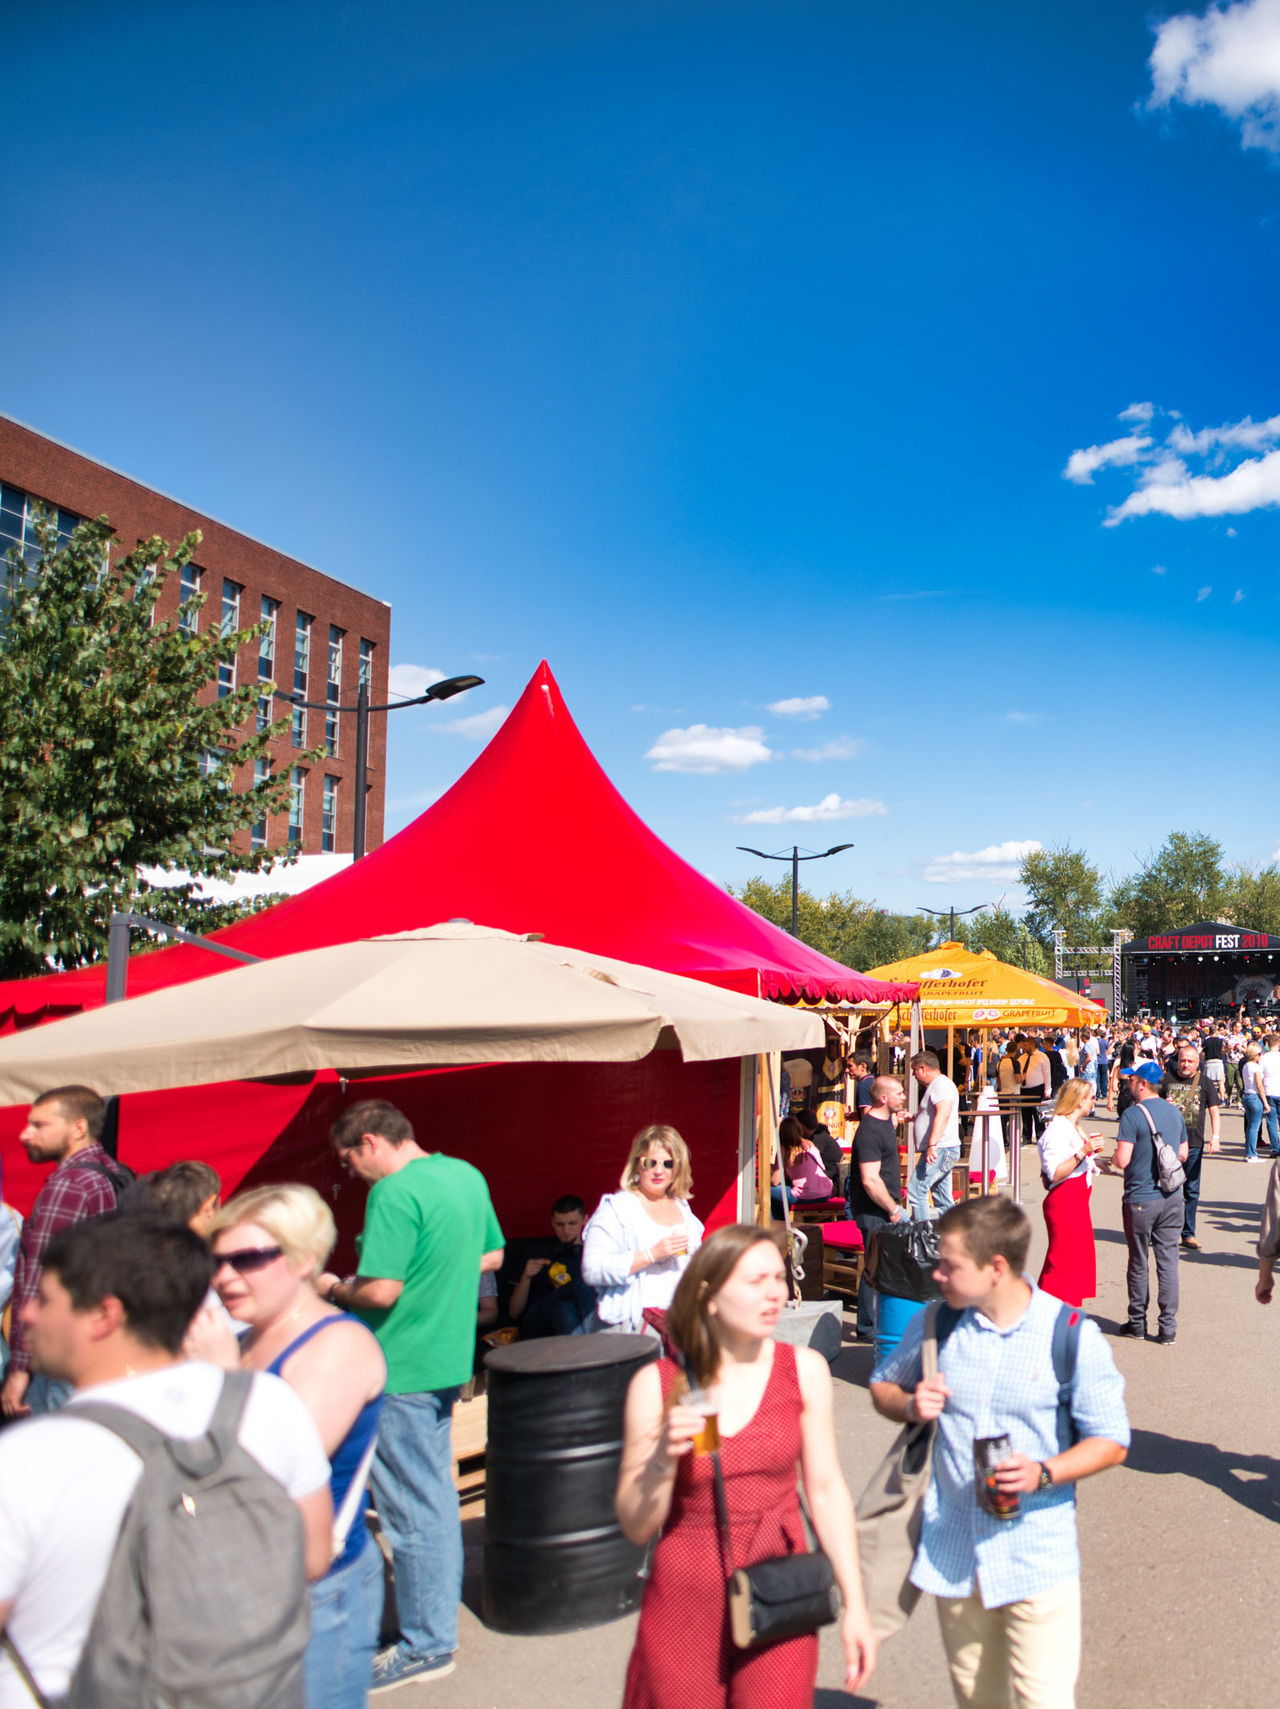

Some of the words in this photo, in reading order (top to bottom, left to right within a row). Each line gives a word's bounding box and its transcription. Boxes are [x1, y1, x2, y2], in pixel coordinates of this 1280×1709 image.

[1148, 936, 1180, 950] CRAFT
[1182, 935, 1214, 949] DEPOT
[1215, 934, 1240, 949] FEST
[1241, 934, 1268, 948] 2019
[1003, 1009, 1055, 1017] GRAPEFRUIT
